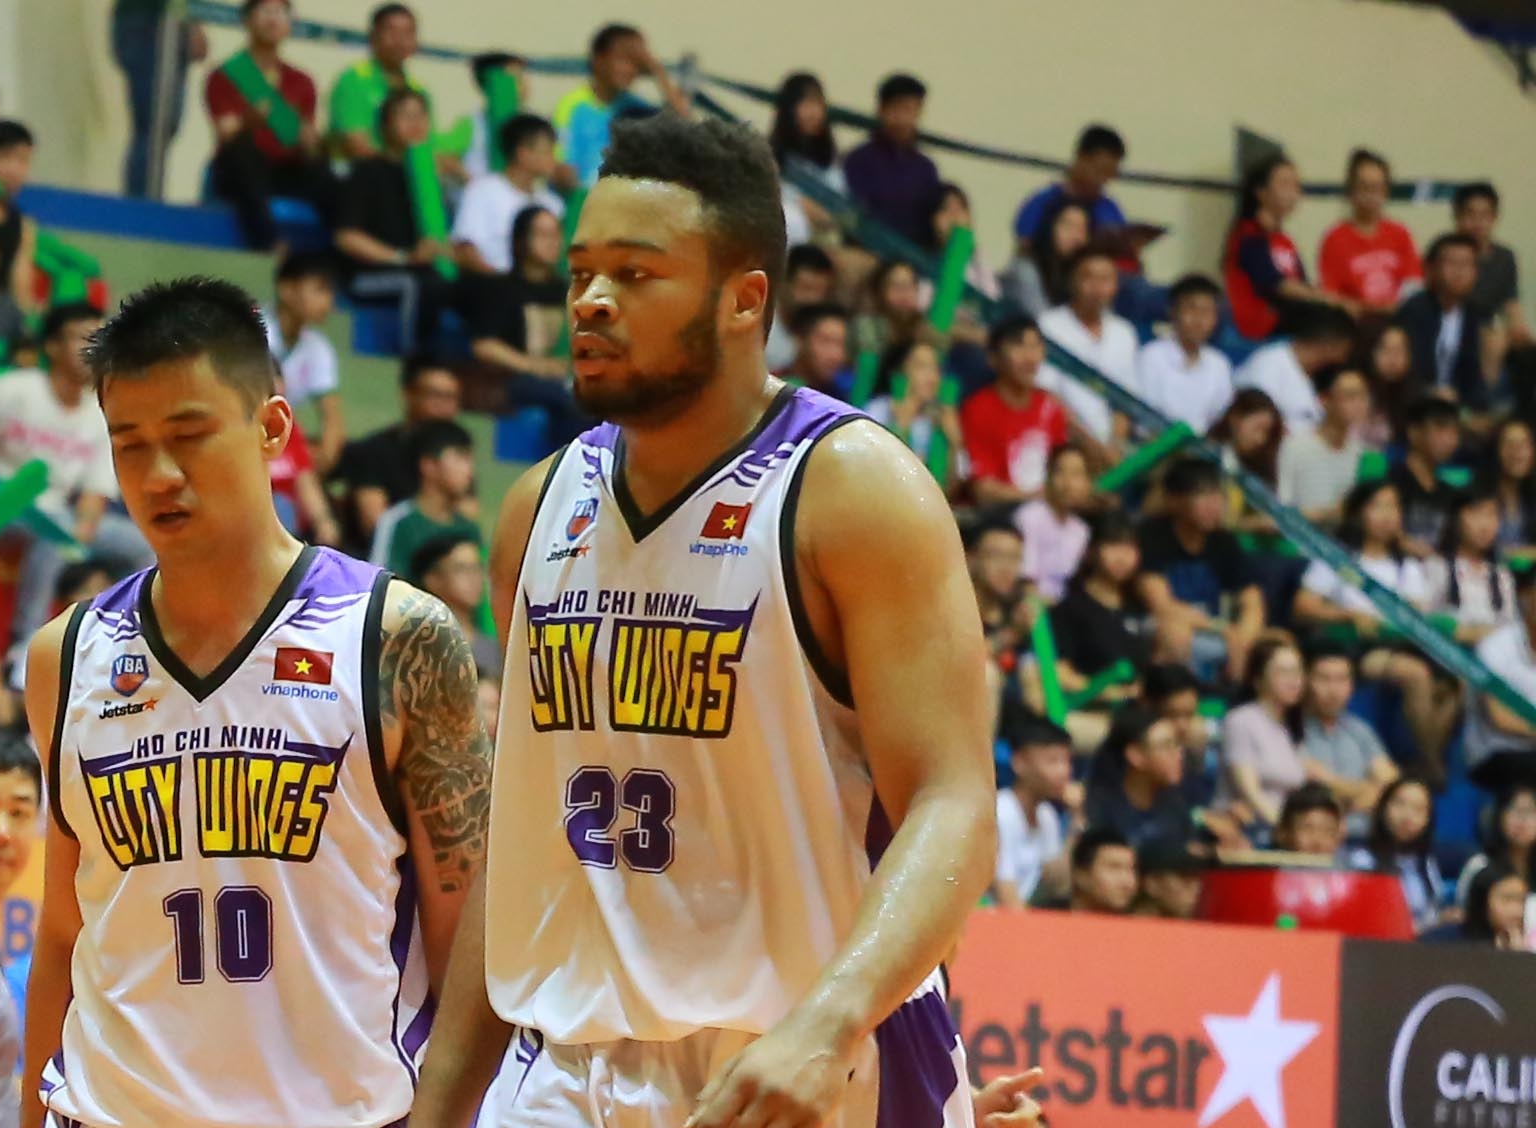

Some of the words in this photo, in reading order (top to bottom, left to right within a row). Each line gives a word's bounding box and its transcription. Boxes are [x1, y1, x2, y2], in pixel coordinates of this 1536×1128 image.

[562, 593, 588, 614] HO
[597, 590, 636, 614] CHI
[645, 592, 694, 618] MINH
[115, 657, 145, 676] VBA
[261, 683, 339, 702] vinaphone
[528, 618, 602, 732] CITY
[608, 618, 746, 739] WINGS
[99, 702, 145, 720] Jetstar
[136, 735, 165, 760] HO
[175, 726, 211, 752] CHI
[220, 724, 283, 750] MINH
[83, 757, 183, 871] CITY
[192, 752, 340, 863] WINGS
[563, 765, 677, 875] 23
[163, 885, 274, 985] 10
[948, 996, 1212, 1112] etstar
[1437, 1049, 1536, 1105] CALI
